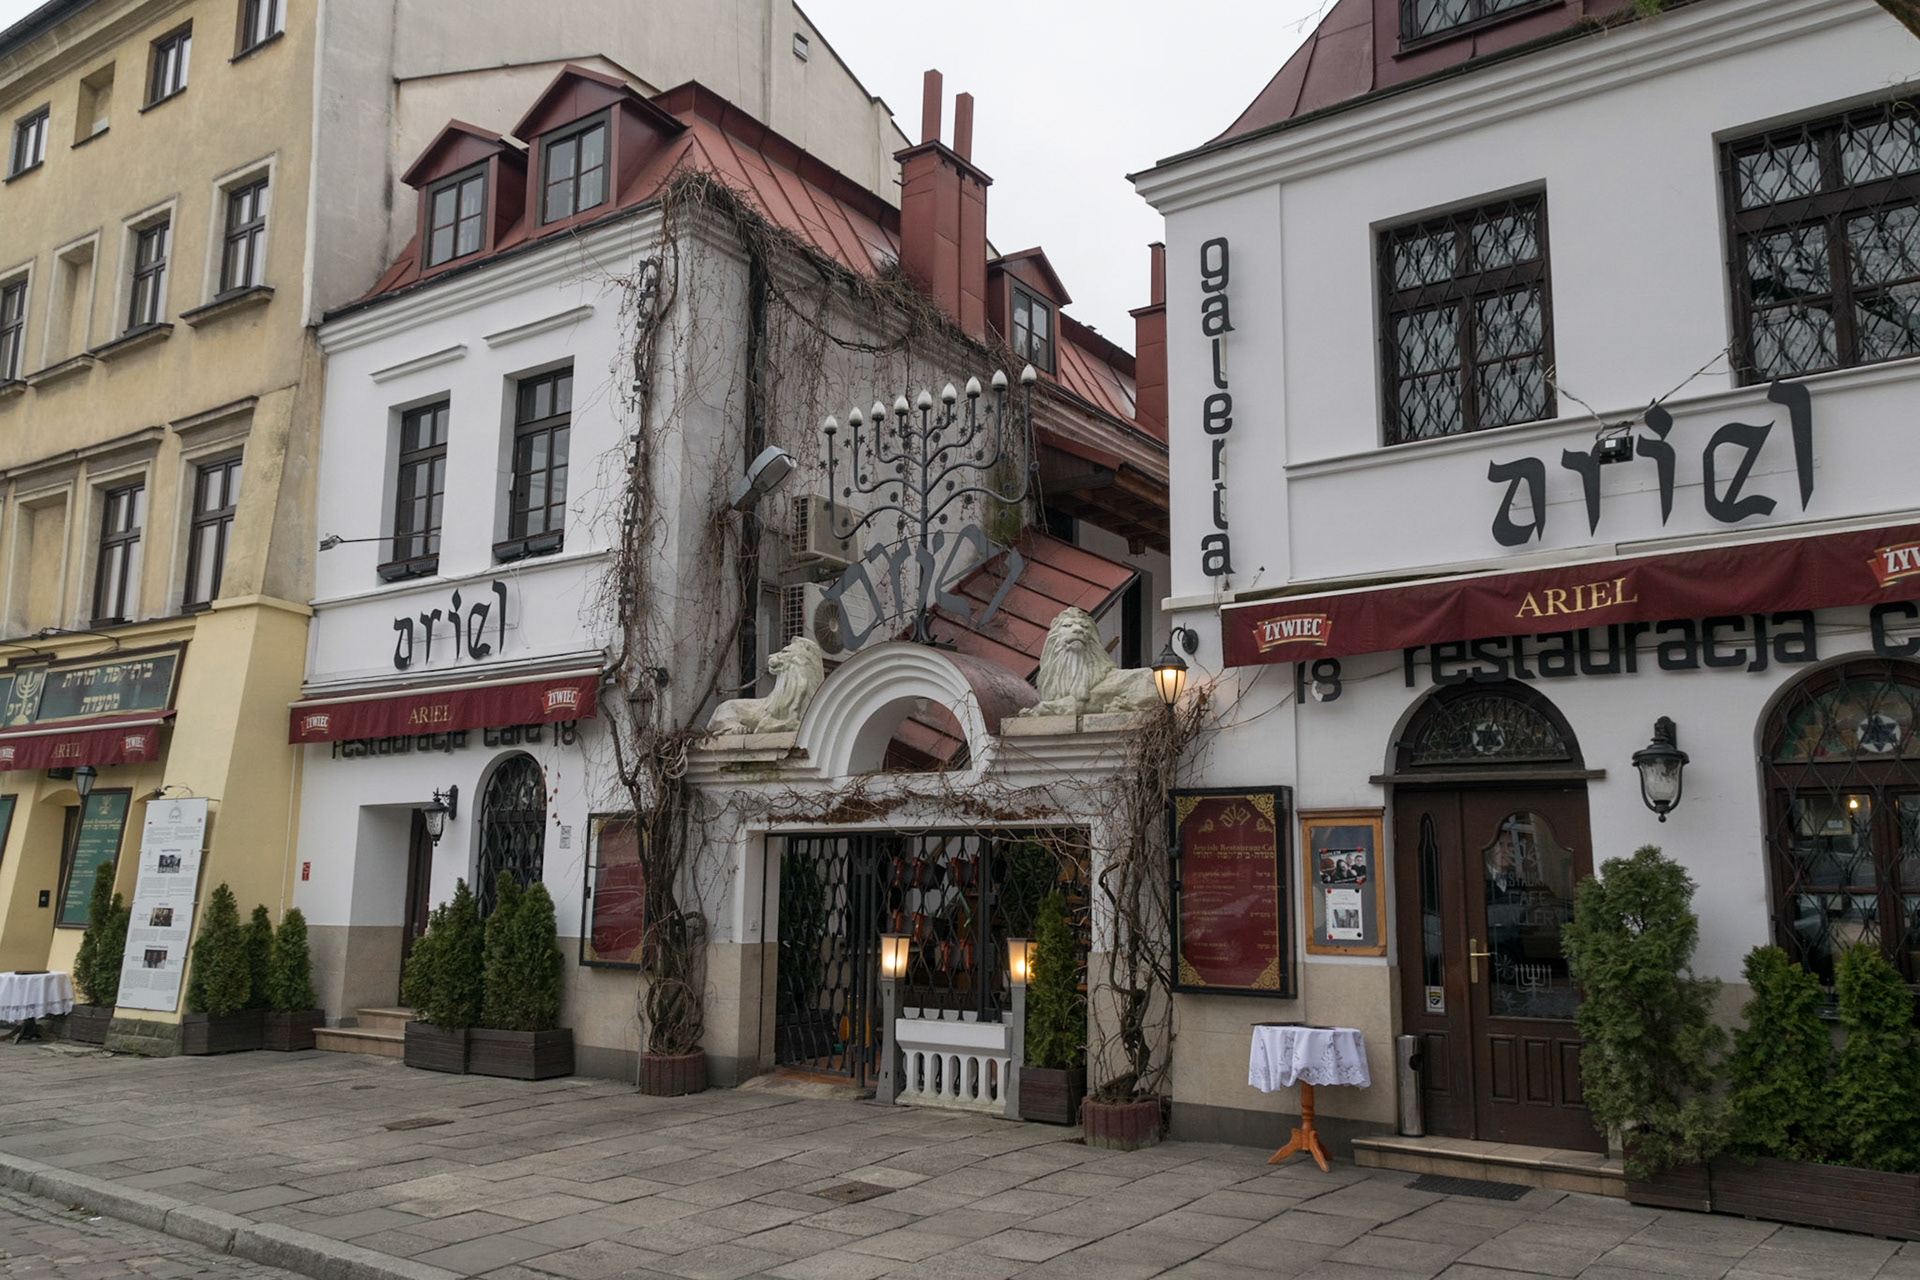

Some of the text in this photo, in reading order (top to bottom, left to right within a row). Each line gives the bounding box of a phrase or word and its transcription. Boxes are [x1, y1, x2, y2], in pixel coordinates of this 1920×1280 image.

[1200, 237, 1236, 577] galeria
[1488, 378, 1814, 547] ariel
[393, 579, 508, 671] ariel
[1263, 616, 1323, 643] ŻYWIEC
[1515, 576, 1638, 618] ARIEL
[1298, 658, 1342, 703] 18
[1404, 609, 1820, 688] restauracja
[408, 705, 453, 724] ARIEL
[547, 689, 578, 707] ŻYWIEC
